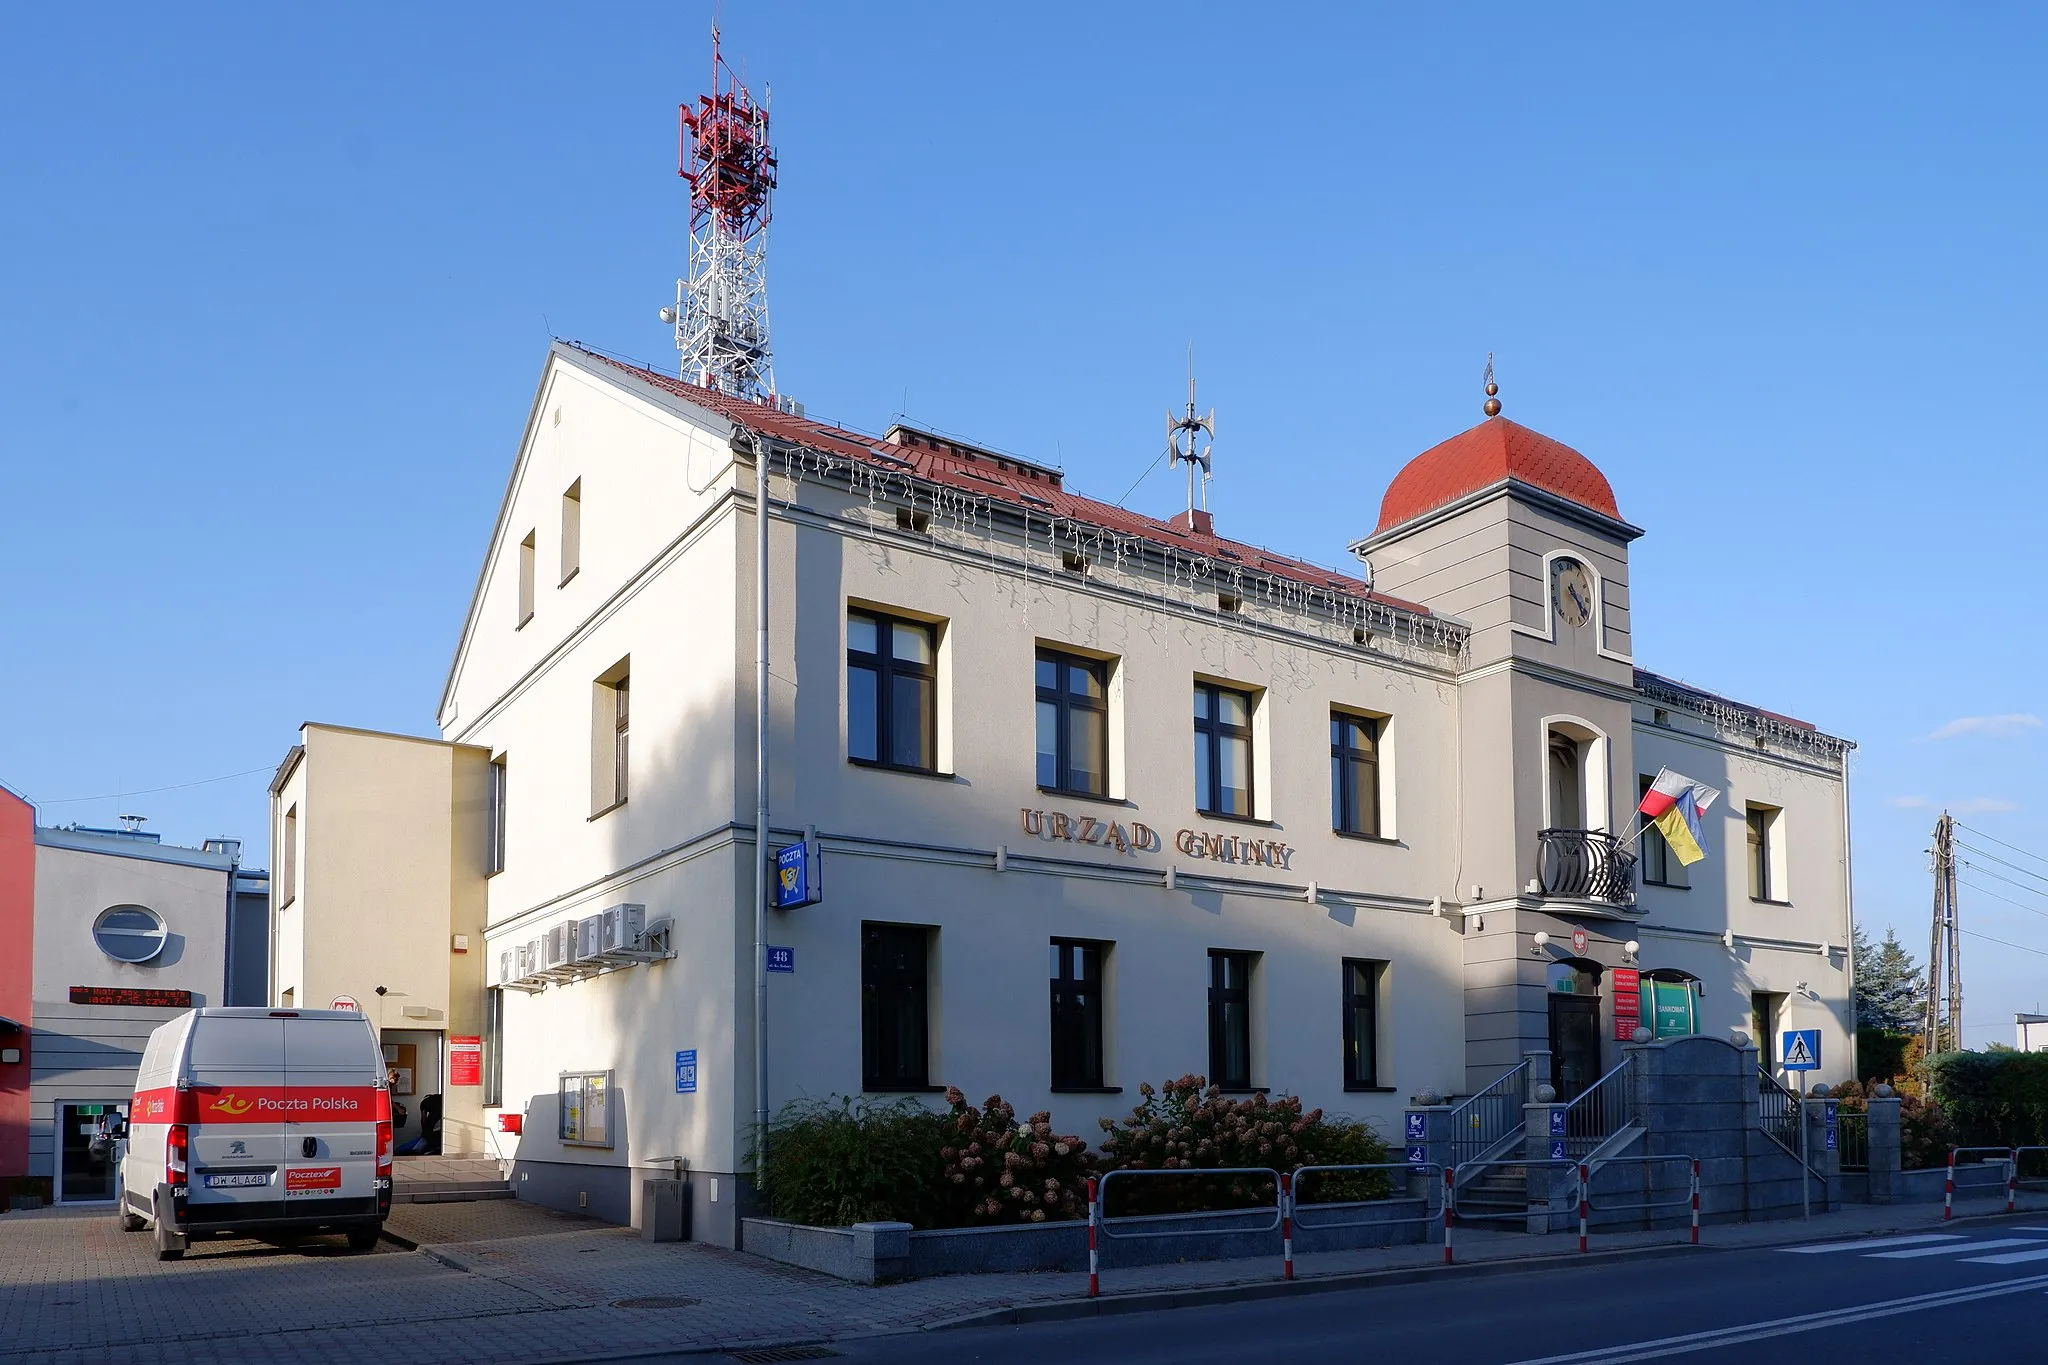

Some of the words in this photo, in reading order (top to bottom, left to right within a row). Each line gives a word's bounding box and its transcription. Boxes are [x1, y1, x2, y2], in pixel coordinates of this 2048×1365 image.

[1021, 808, 1152, 853] URZĄD
[1175, 828, 1287, 865] GMINY
[778, 849, 801, 865] POCZTA
[773, 950, 788, 962] 48
[1657, 1005, 1685, 1013] BANKOMAT
[258, 1097, 308, 1110] Poczta
[312, 1097, 358, 1110] Polska
[212, 1176, 227, 1185] DW
[231, 1175, 264, 1185] 4LA48
